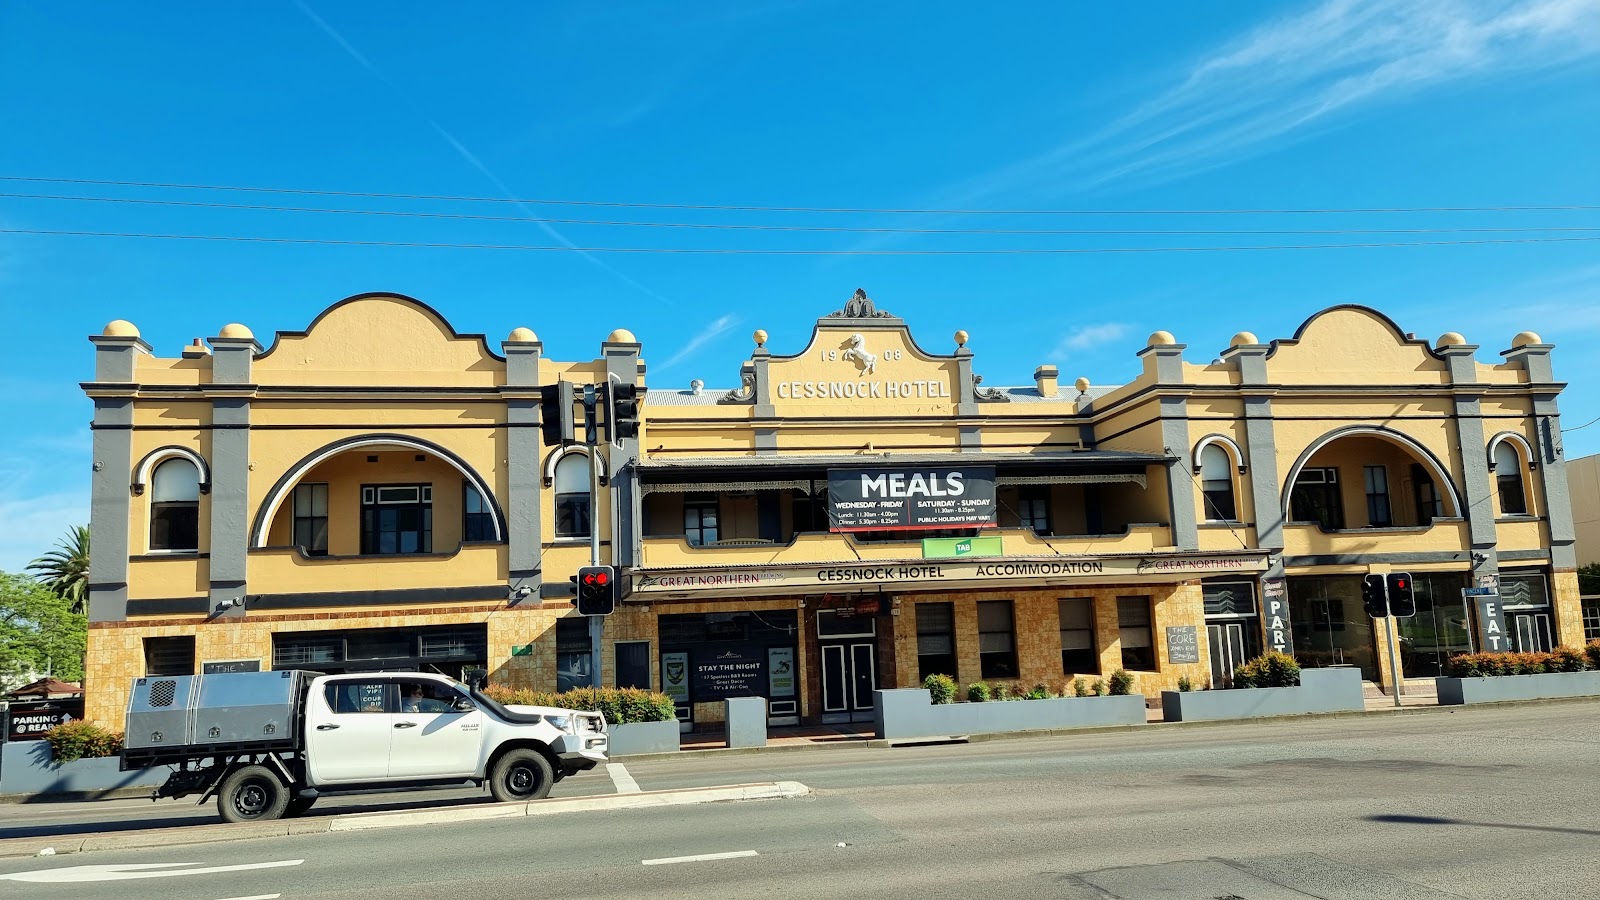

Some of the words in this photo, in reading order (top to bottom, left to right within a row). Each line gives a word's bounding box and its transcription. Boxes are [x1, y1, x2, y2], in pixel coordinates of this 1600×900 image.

[821, 350, 837, 362] 19
[884, 350, 902, 361] 08
[778, 381, 882, 399] CESSNOCK
[886, 380, 950, 398] HOTEL
[861, 472, 965, 498] MEALS
[976, 562, 1103, 577] ACCOMMODATION
[1156, 560, 1186, 570] GREAT
[1189, 559, 1242, 569] NORTHERN
[660, 576, 696, 587] GREAT
[698, 574, 759, 585] NORTHERN
[817, 568, 894, 582] CESSNOCK
[900, 567, 944, 579] HOTEL
[1486, 603, 1500, 650] EAT
[13, 715, 58, 724] PARKING
[17, 725, 26, 733] @
[28, 724, 54, 732] REAR
